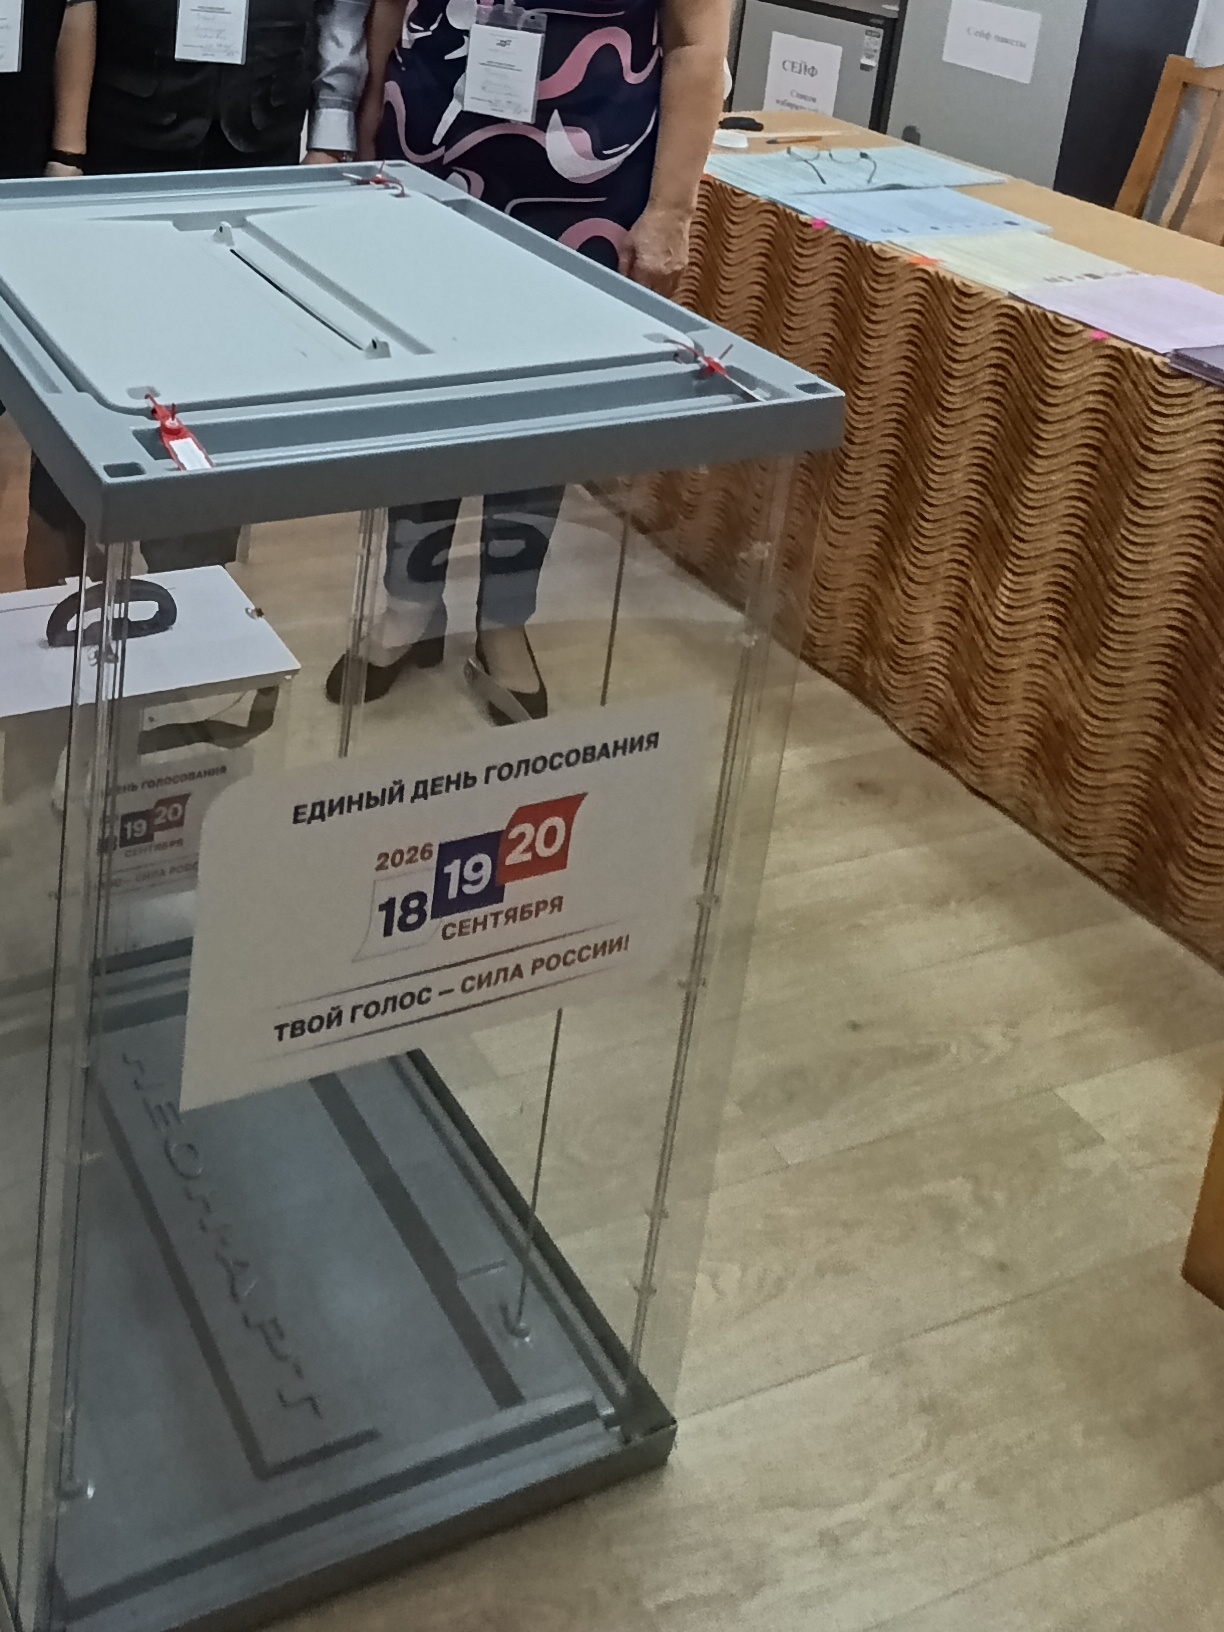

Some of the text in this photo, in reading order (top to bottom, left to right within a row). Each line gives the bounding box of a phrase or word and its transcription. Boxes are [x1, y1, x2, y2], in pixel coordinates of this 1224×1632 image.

[782, 59, 819, 78] СЕЙФ
[292, 731, 660, 824] ЕДИНЫЙ ДЕНЬ ГОЛОСОВАНИЯ
[123, 803, 184, 840] 19 20
[375, 842, 434, 872] 2026
[378, 816, 566, 938] 18 19 20
[441, 895, 564, 941] СЕНТЯБРЯ
[274, 1009, 343, 1042] ТВОЙ
[350, 986, 433, 1024] ГОЛОС
[461, 963, 524, 994] СИЛА
[531, 934, 630, 977] РОССИИ!
